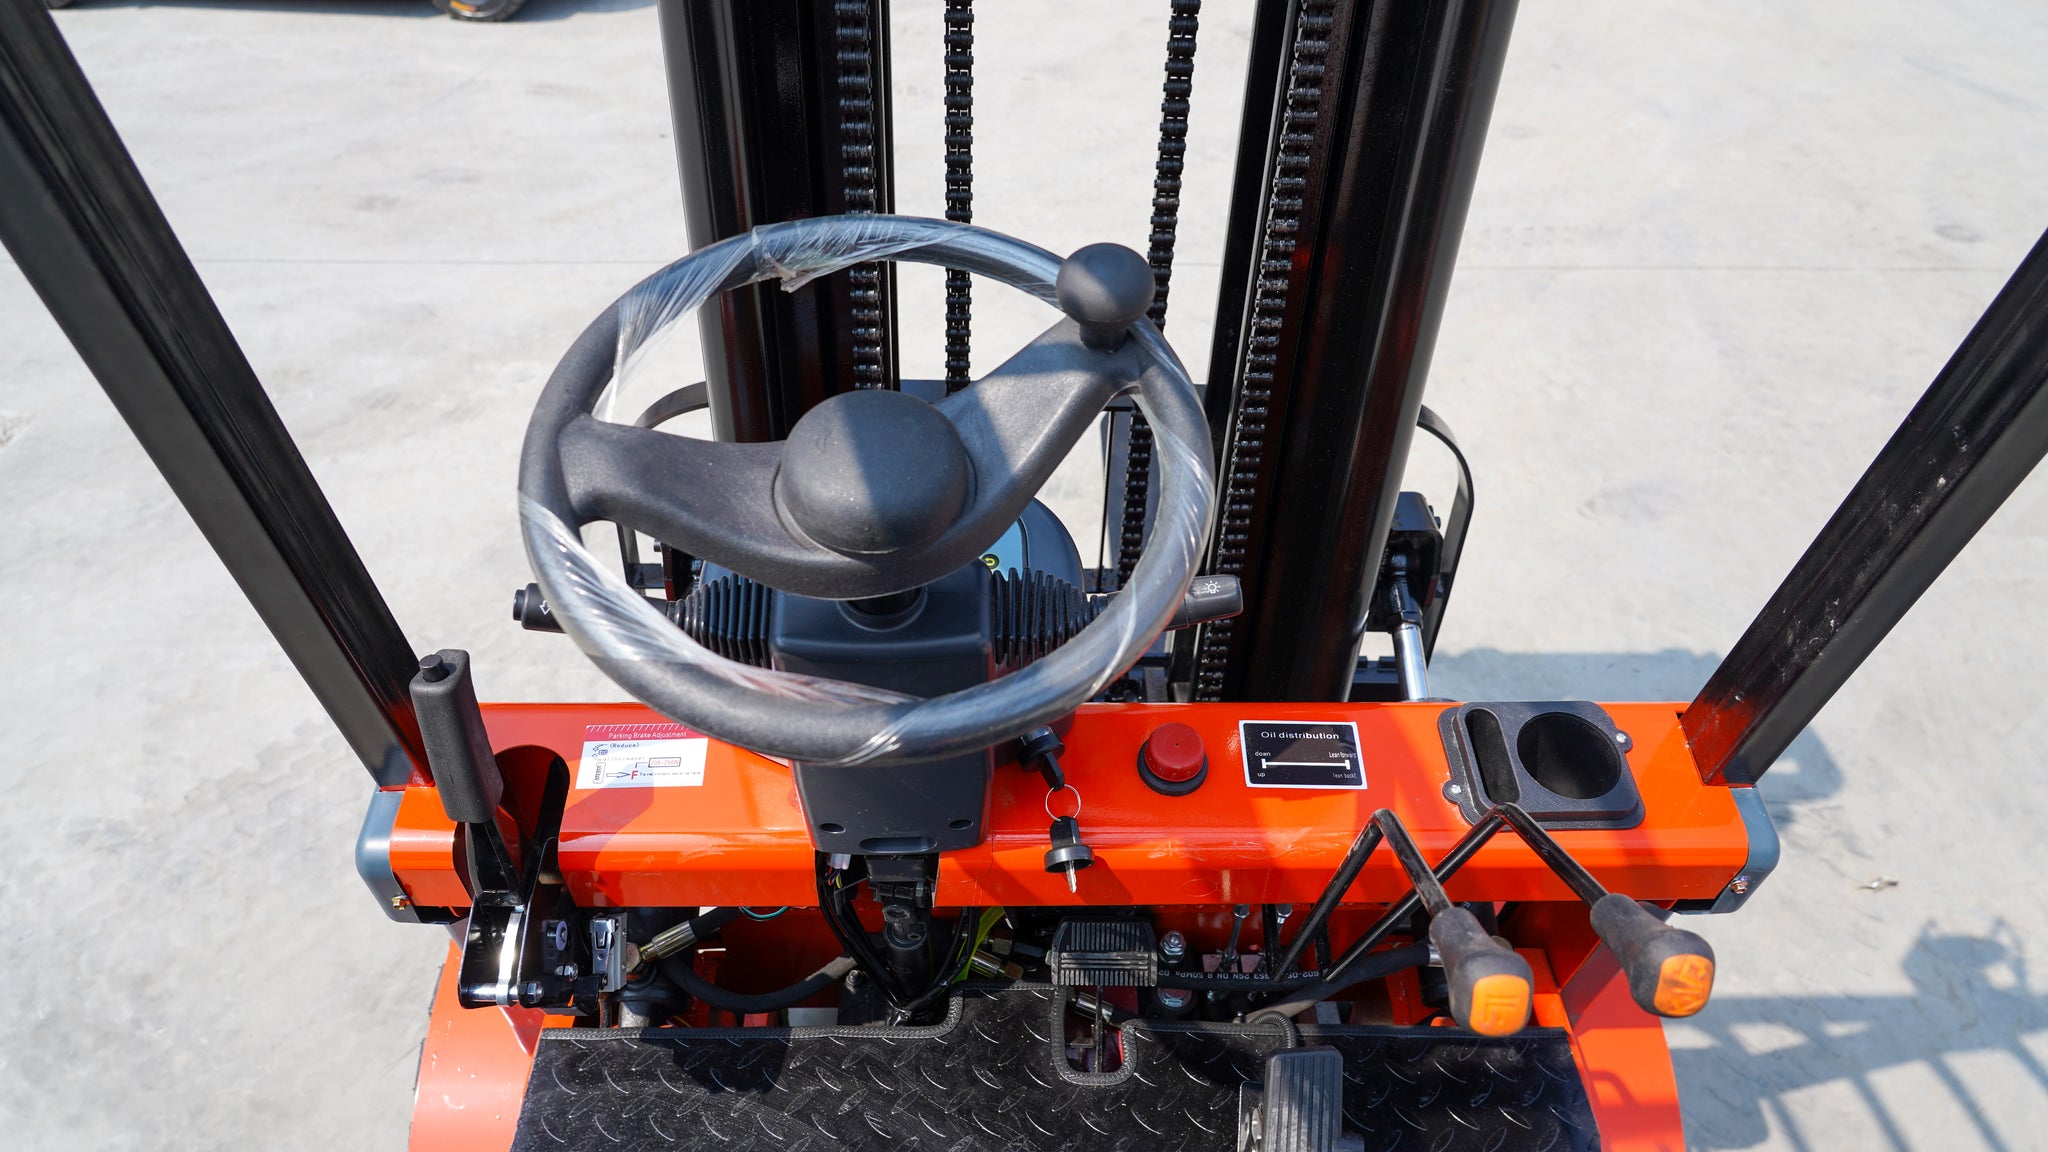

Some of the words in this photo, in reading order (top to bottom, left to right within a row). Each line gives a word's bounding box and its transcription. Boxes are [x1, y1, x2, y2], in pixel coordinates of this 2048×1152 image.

[608, 732, 632, 740] Parking
[652, 731, 687, 739] Adjustment
[1278, 731, 1340, 740] distribution
[631, 770, 639, 779] F
